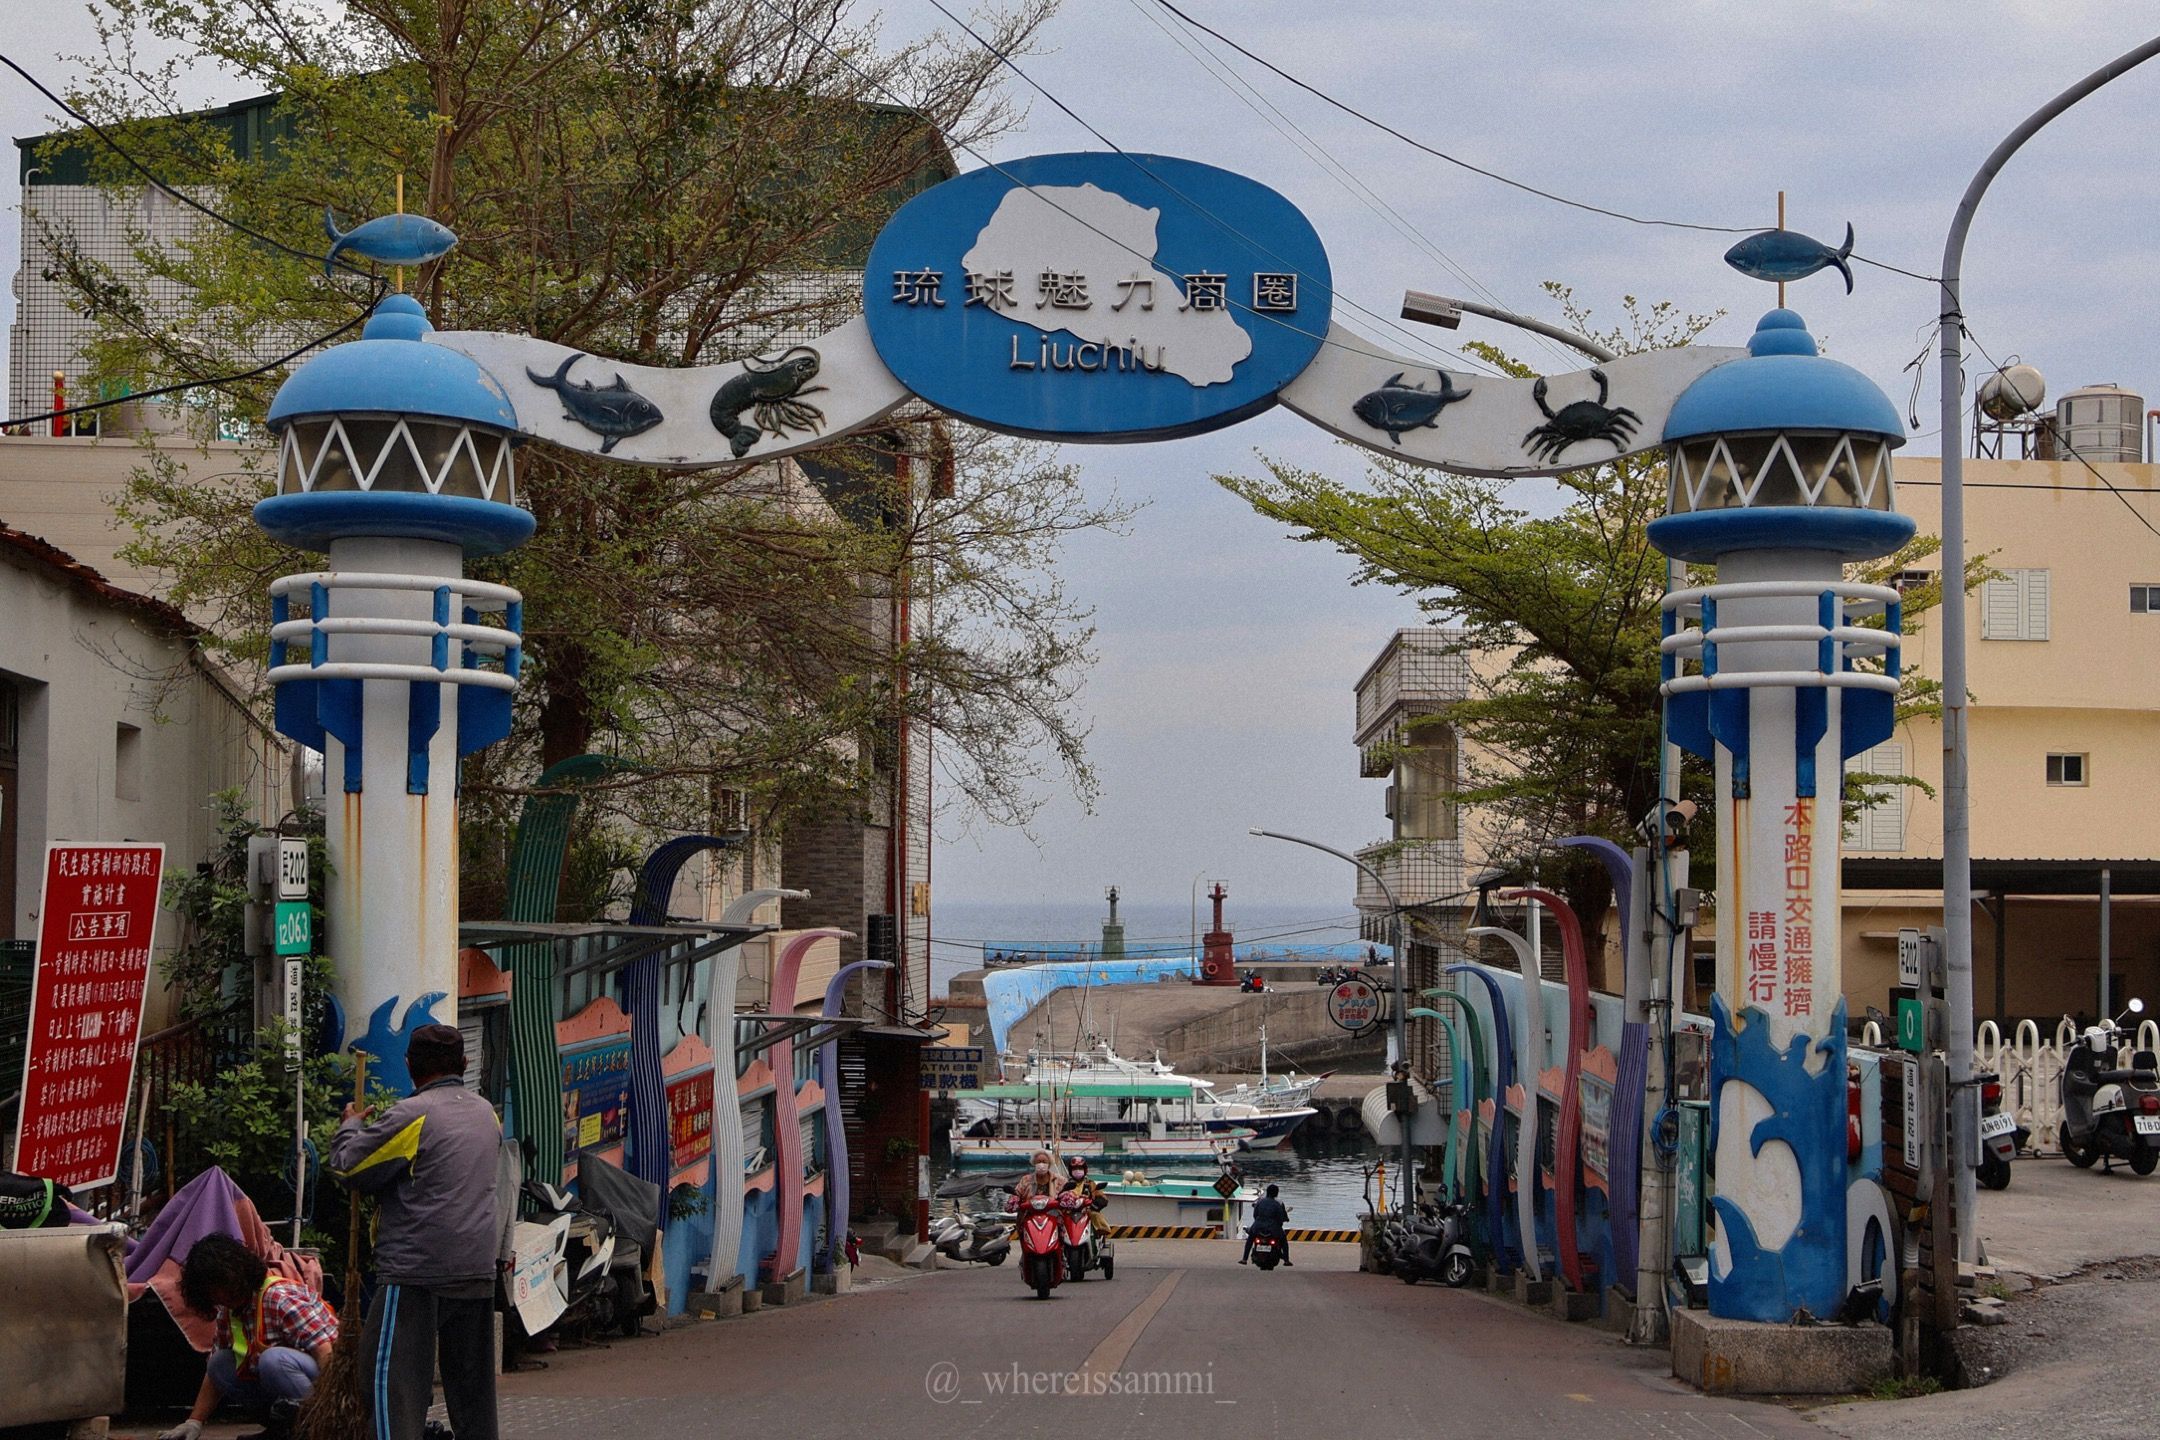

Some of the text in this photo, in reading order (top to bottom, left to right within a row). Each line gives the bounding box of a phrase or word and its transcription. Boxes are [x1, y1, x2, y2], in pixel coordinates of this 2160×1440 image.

[892, 266, 1299, 311] 琉球魅力商圈
[1010, 335, 1167, 372] Liuchiu
[74, 913, 127, 939] 公告事項
[1783, 800, 1813, 1017] 本路口交通擁擠
[1747, 910, 1778, 1003] 請慢行
[1906, 1008, 1914, 1041] 0
[920, 1063, 949, 1072] ATM
[920, 1073, 978, 1090] 提款機
